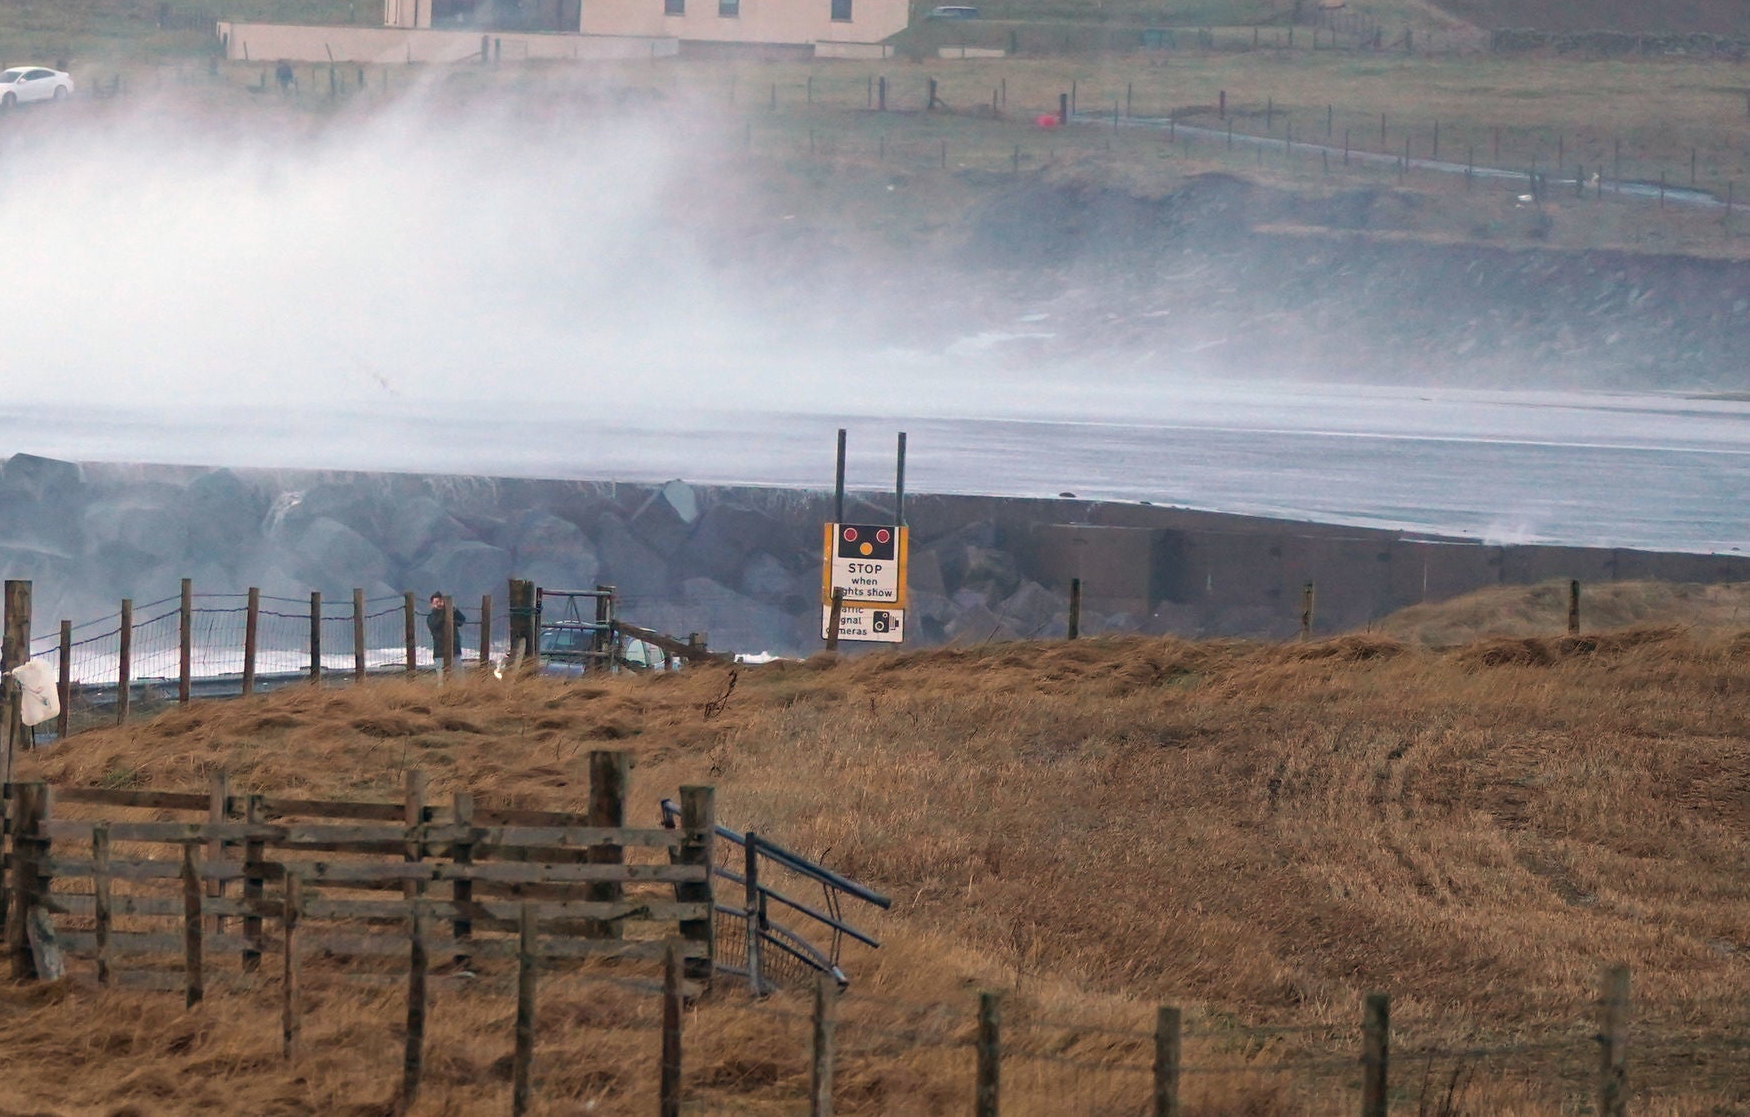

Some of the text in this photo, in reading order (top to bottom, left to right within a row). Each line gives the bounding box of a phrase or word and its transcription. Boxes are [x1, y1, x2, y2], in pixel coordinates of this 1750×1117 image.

[848, 563, 883, 574] STOP
[851, 576, 878, 586] when
[842, 587, 893, 597] ghts show
[840, 617, 862, 626] gnal
[826, 627, 868, 636] cmeras
